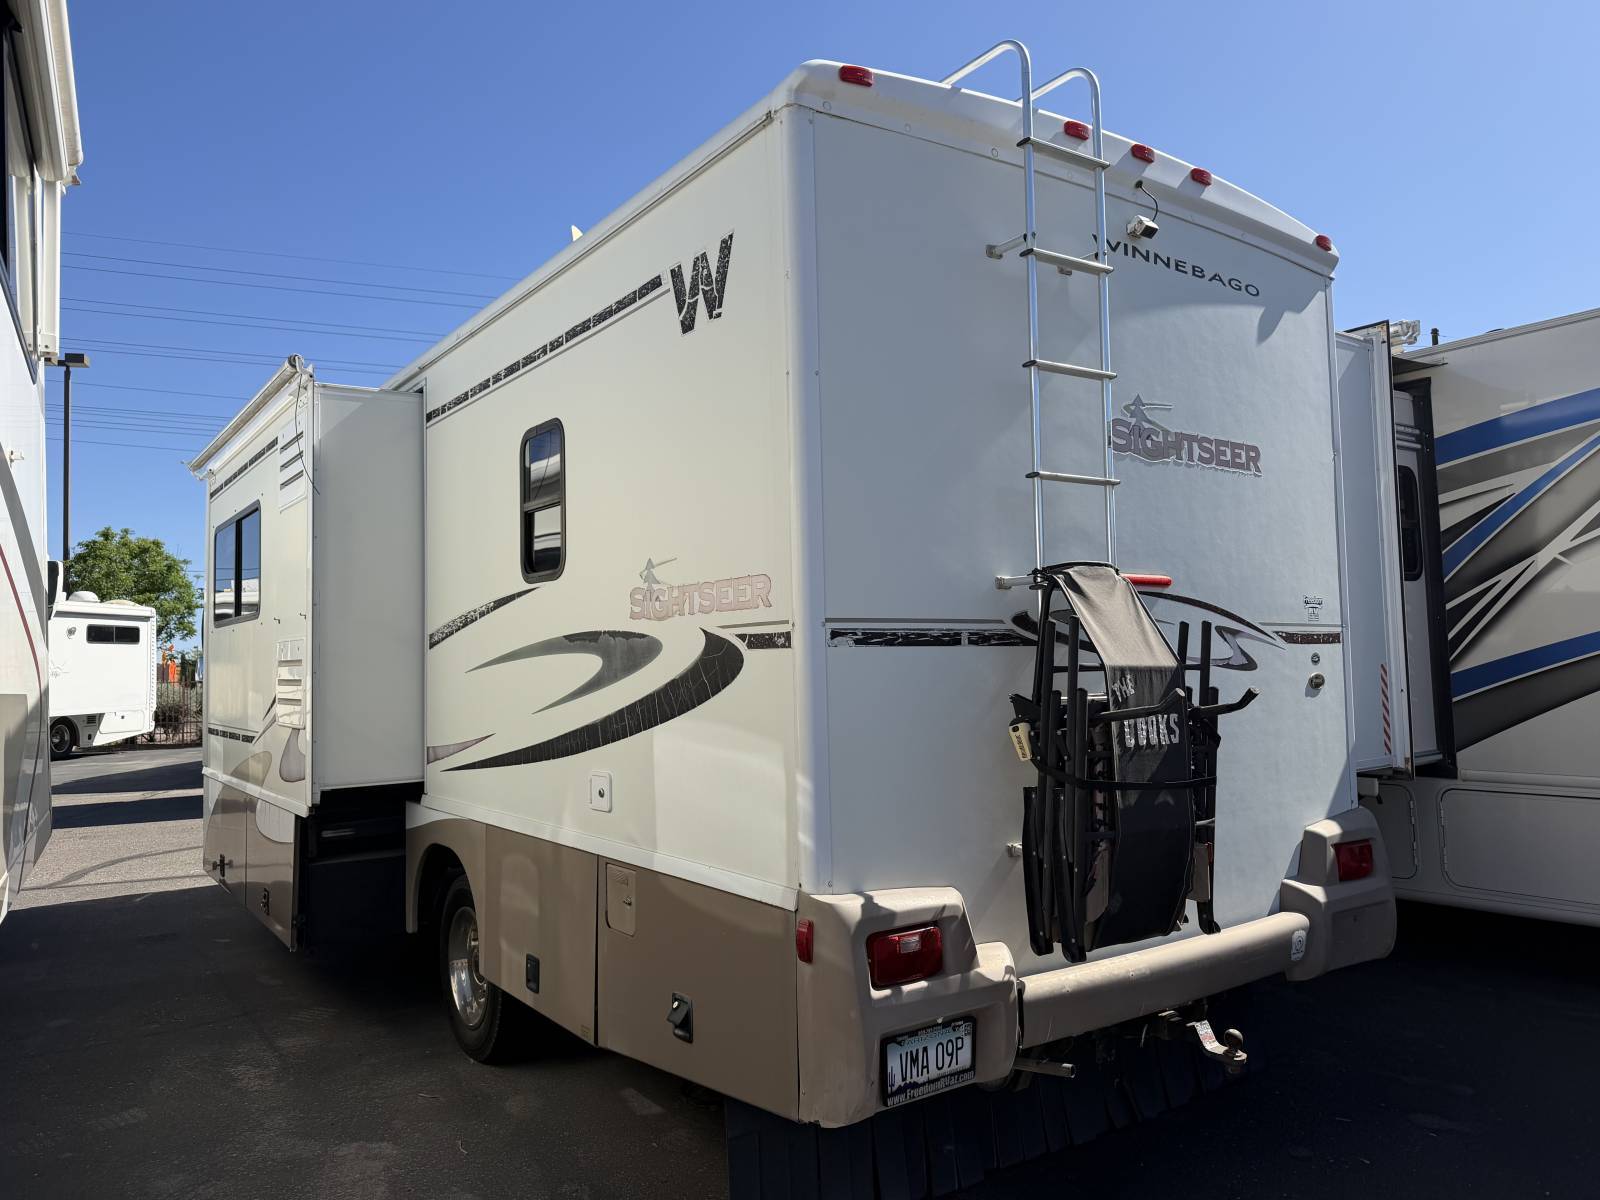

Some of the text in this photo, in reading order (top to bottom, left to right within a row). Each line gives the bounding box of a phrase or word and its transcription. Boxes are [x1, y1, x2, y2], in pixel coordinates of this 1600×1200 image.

[1110, 417, 1262, 476] SIGHTSEER
[629, 573, 773, 622] SIGHTSEER
[900, 1036, 964, 1082] VMA 09P
